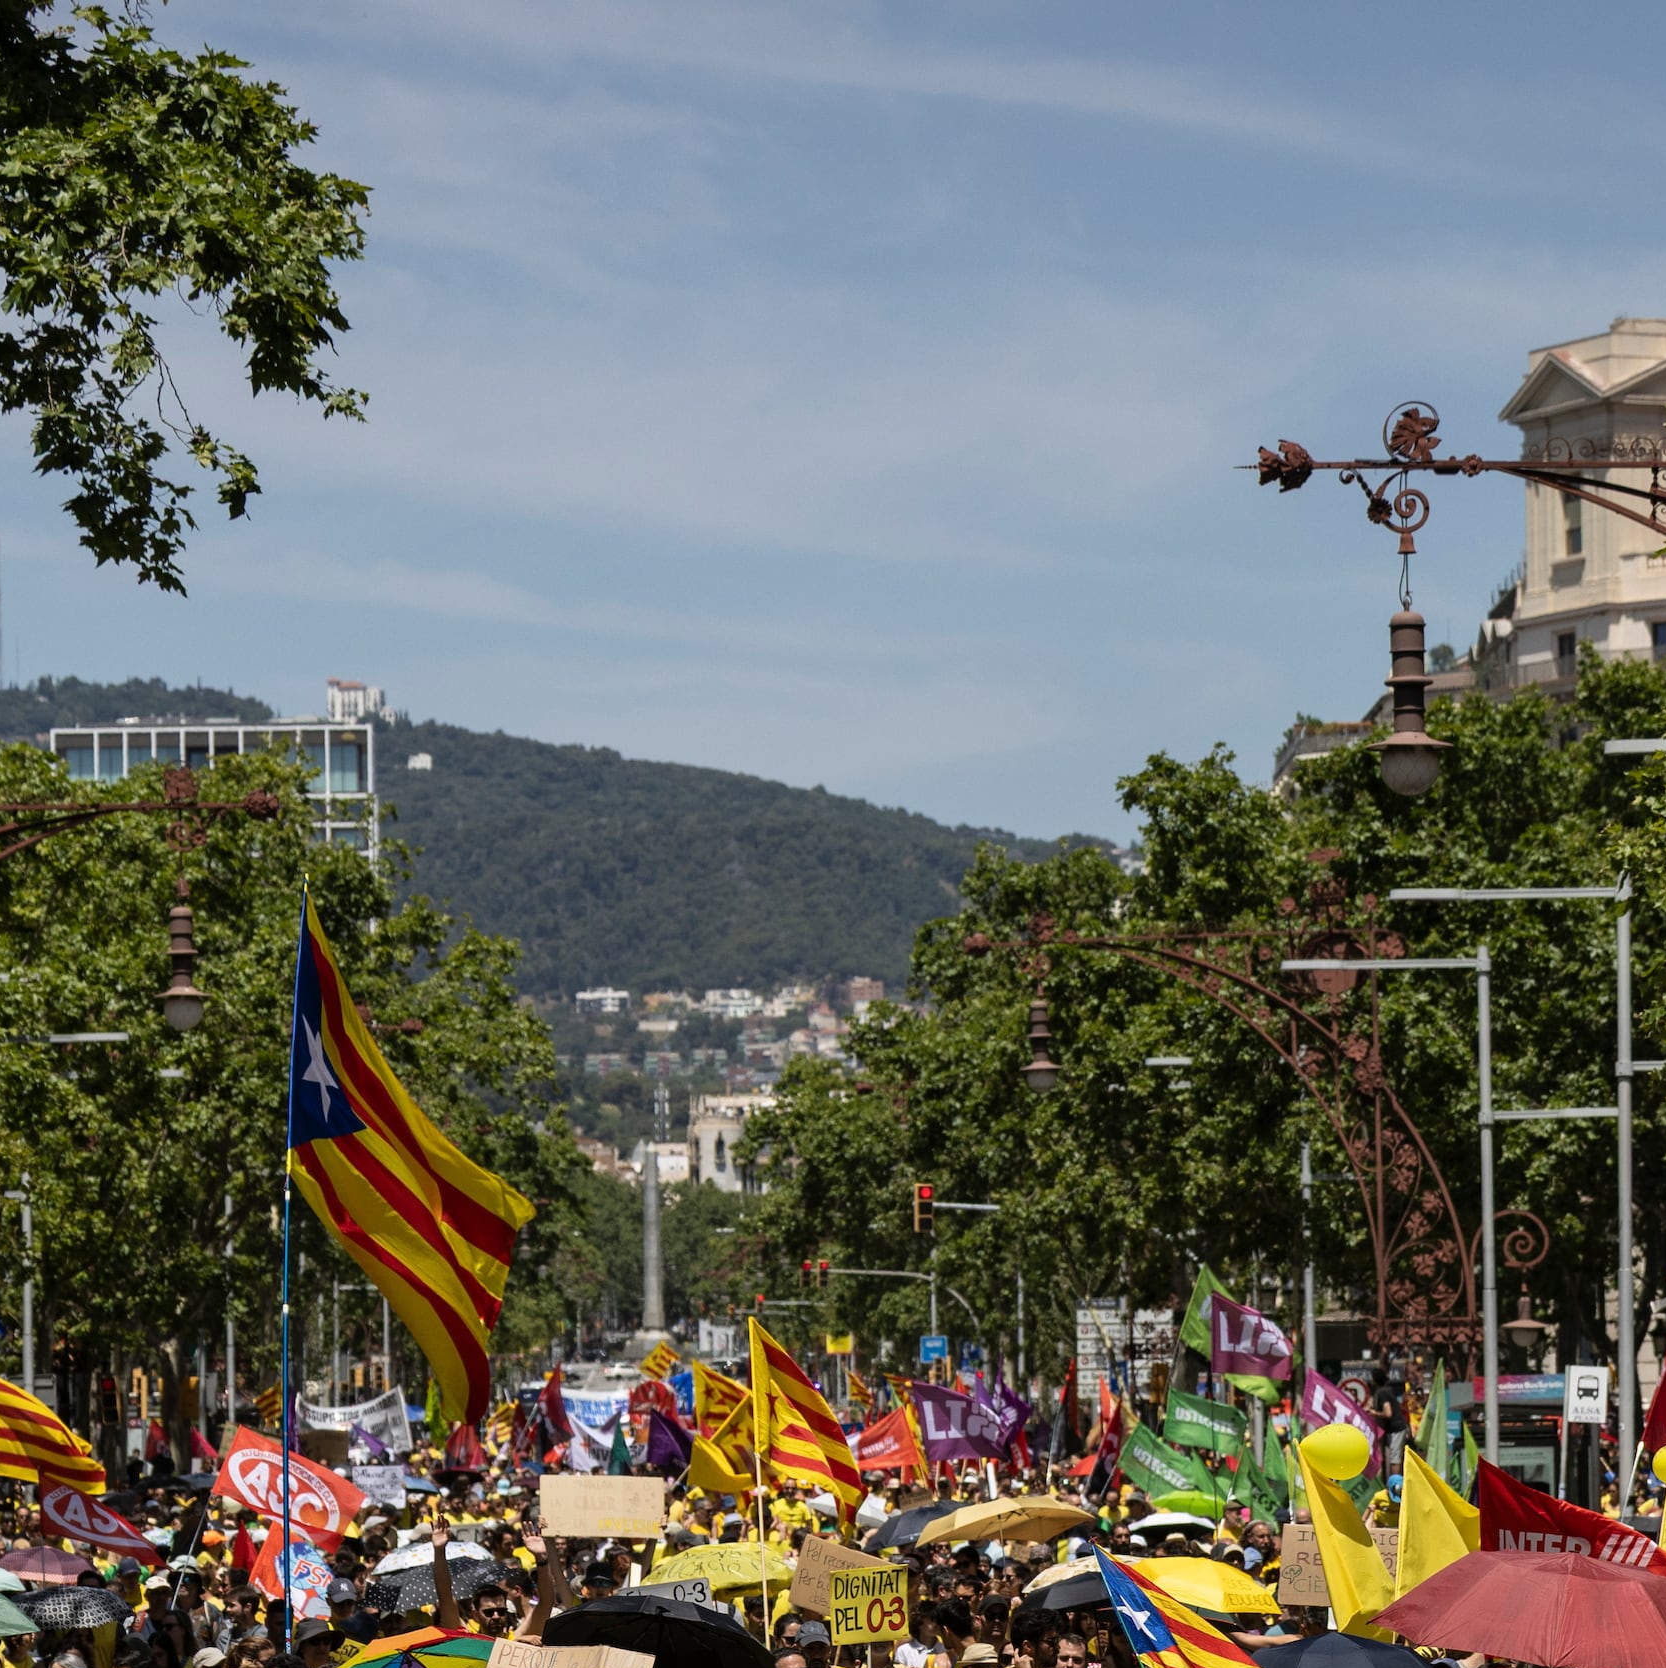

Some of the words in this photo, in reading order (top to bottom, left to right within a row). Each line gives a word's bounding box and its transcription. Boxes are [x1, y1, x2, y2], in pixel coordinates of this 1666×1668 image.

[673, 1582, 708, 1603] 0-3
[834, 1606, 863, 1635] PEL
[866, 1596, 906, 1633] 0-3
